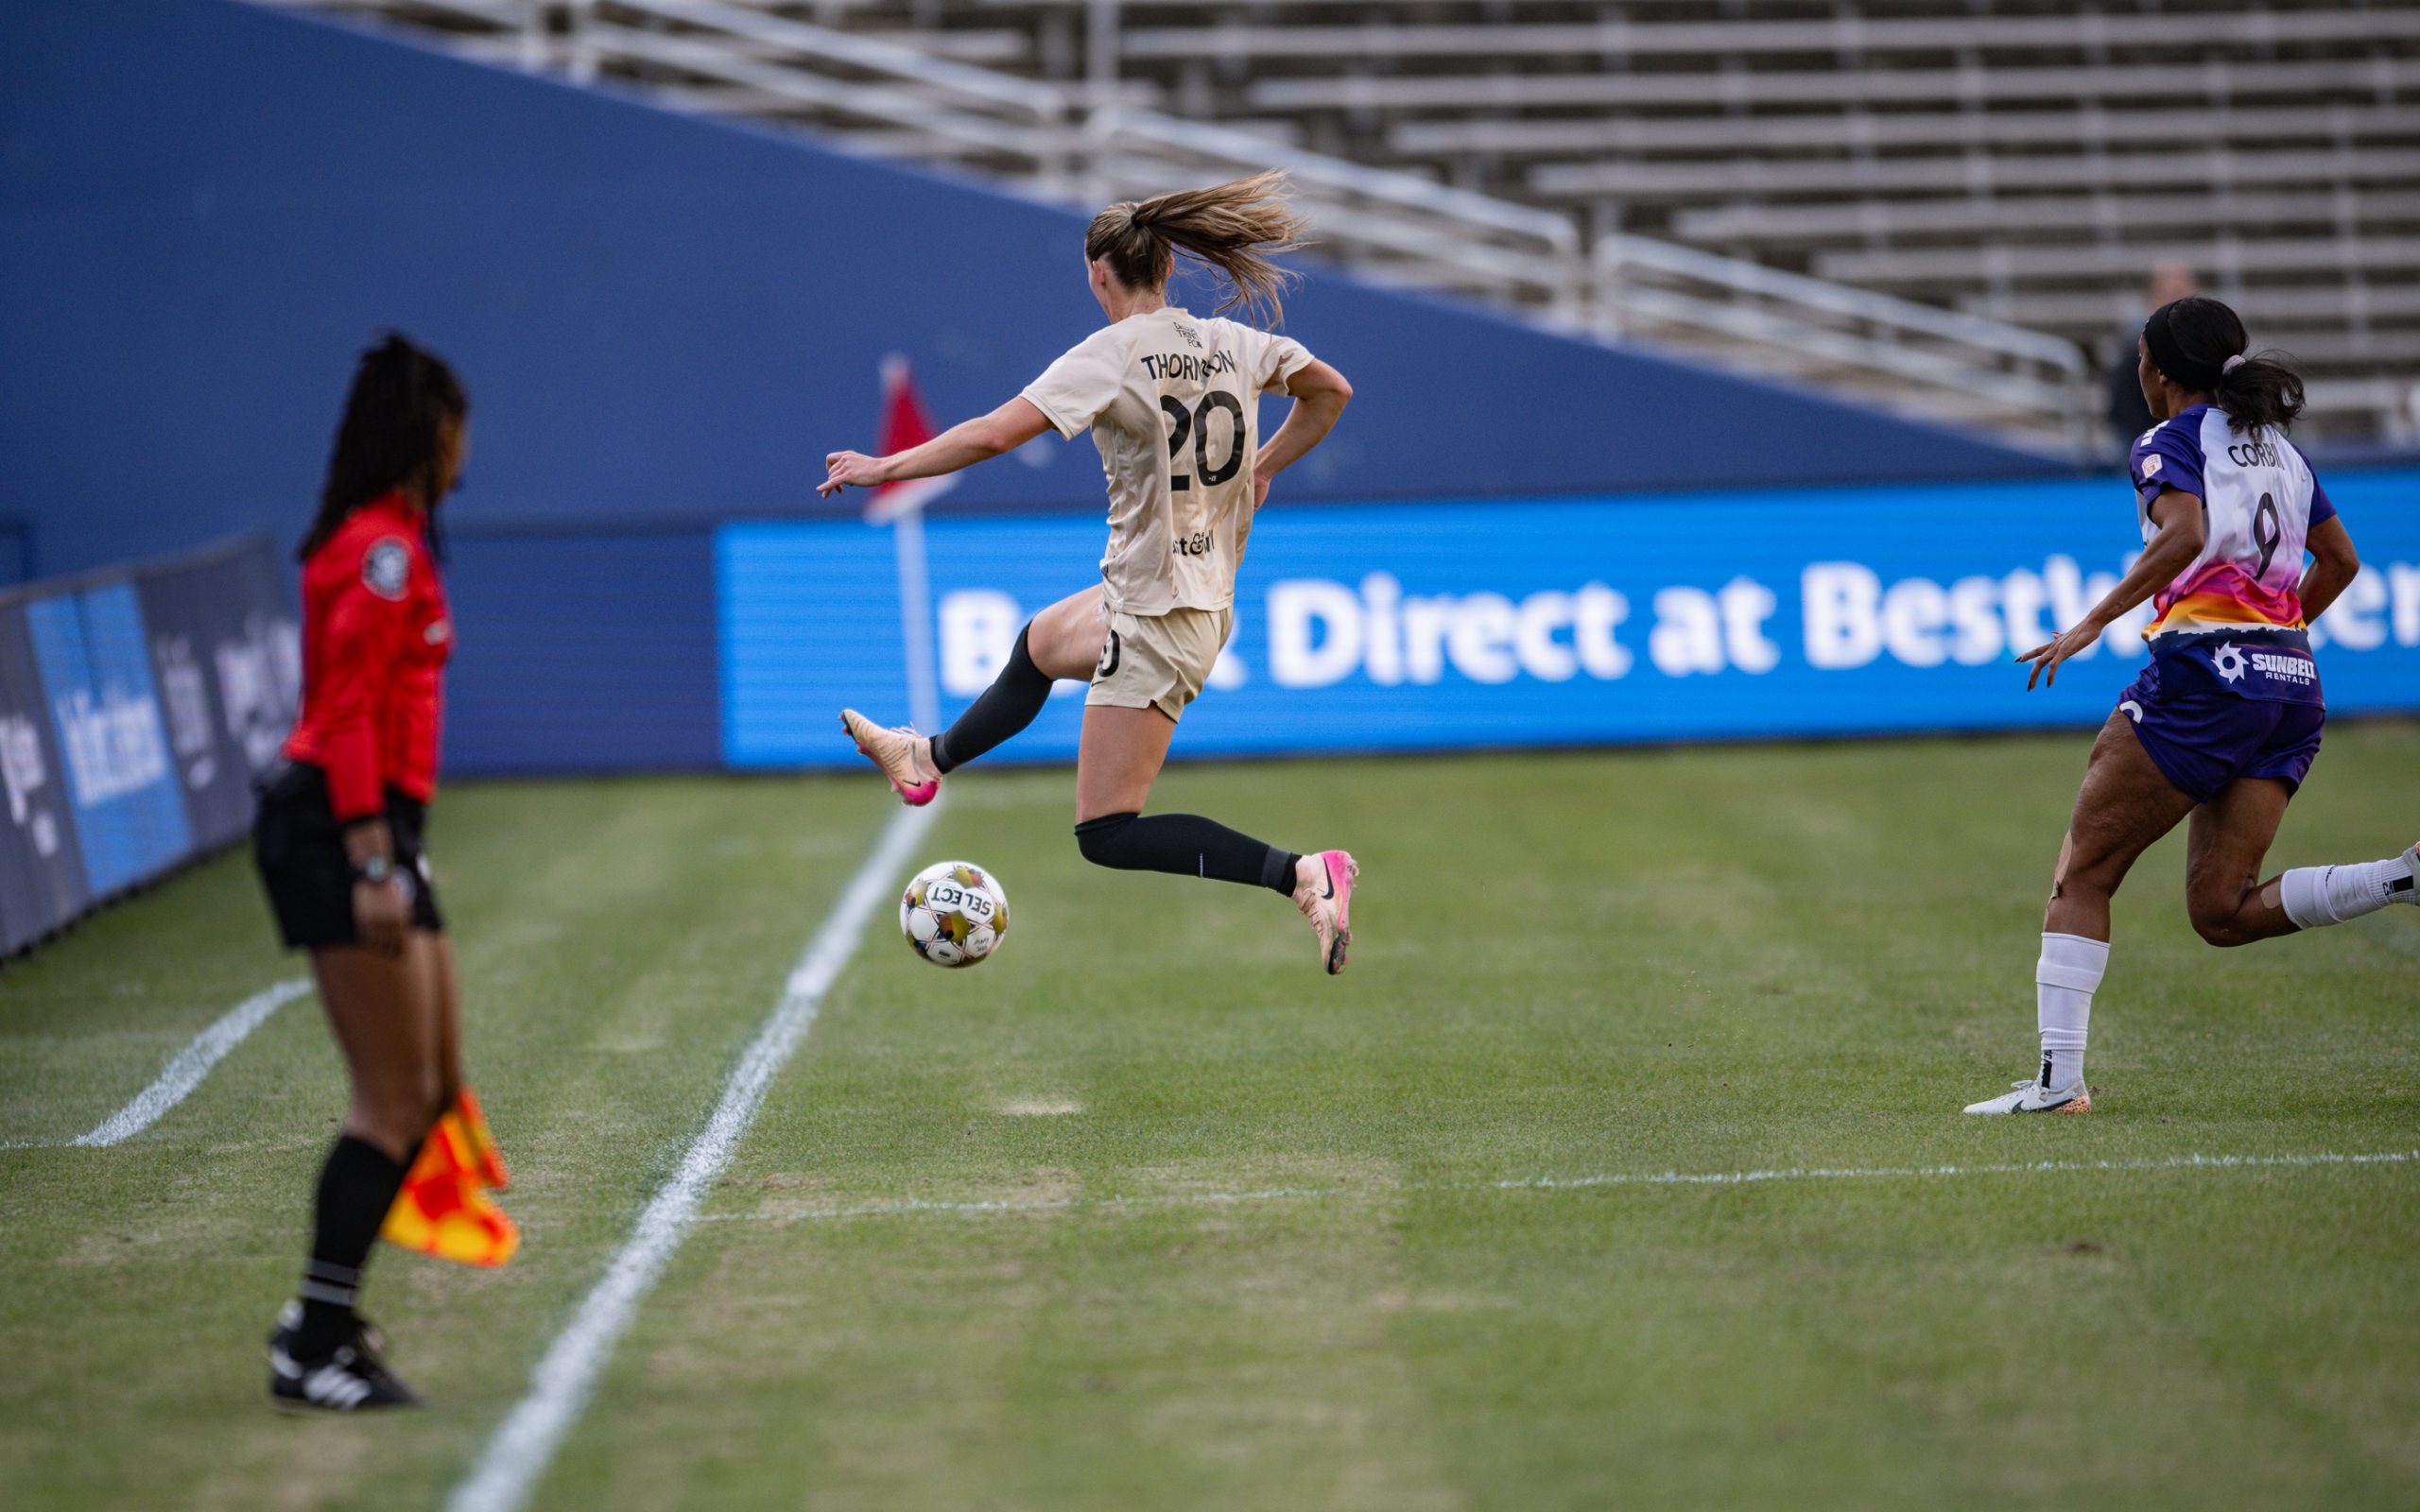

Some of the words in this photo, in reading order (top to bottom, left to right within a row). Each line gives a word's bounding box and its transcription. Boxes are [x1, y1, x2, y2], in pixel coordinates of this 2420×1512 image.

[1159, 390, 1246, 491] 20
[2253, 492, 2281, 582] 9
[1265, 570, 1634, 688] Direct
[1649, 575, 1781, 677] at
[2251, 653, 2316, 679] SUNBELT
[2265, 671, 2310, 685] RENTALS
[930, 886, 992, 916] SELECT
